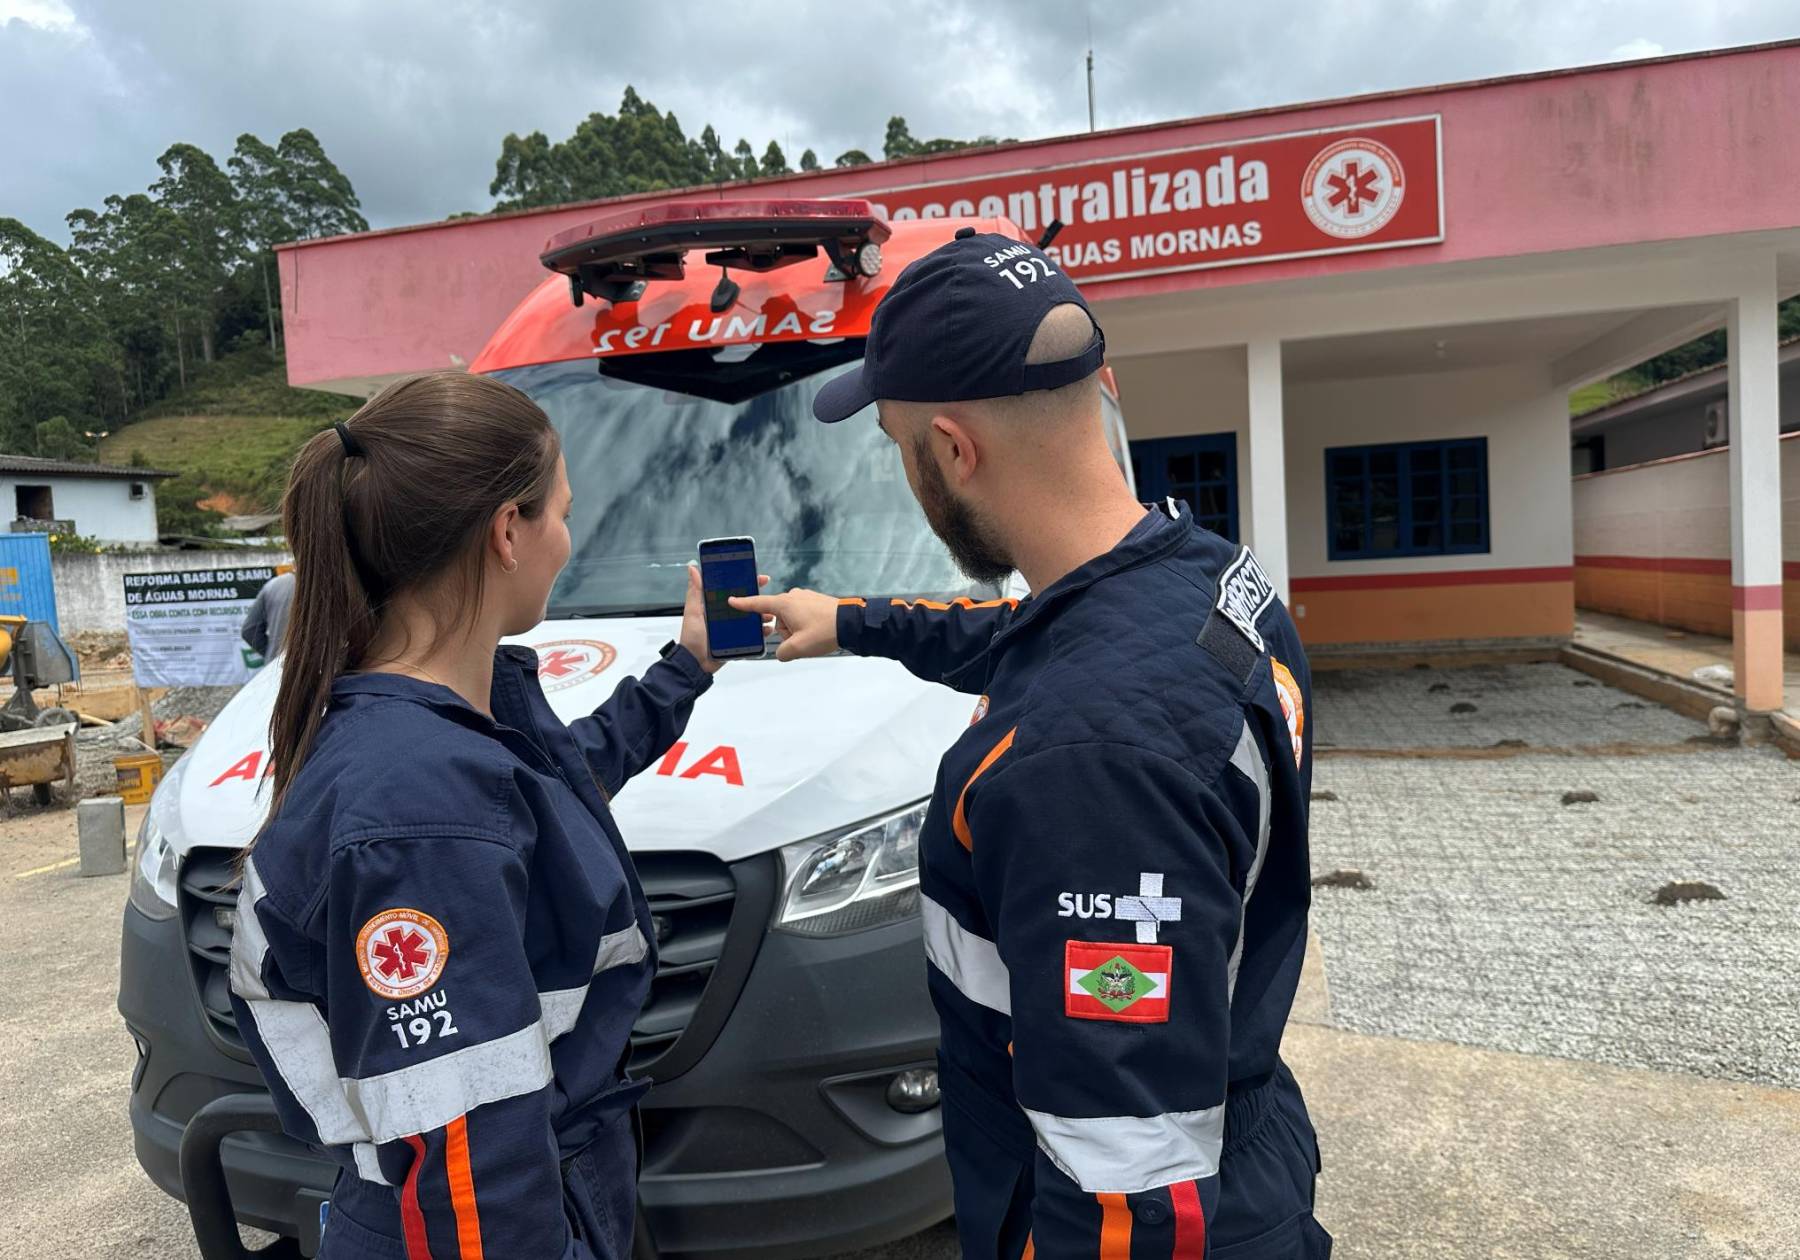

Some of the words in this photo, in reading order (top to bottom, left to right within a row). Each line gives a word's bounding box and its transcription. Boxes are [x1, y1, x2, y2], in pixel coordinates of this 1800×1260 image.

[983, 244, 1031, 268] SAMU
[1043, 239, 1121, 268] GUAS
[1130, 221, 1262, 260] MORNAS
[999, 257, 1057, 289] 192
[125, 574, 181, 587] REFORMA
[183, 572, 215, 584] BASE
[216, 570, 234, 582] DO
[235, 568, 272, 581] SAMU
[127, 592, 143, 604] DE
[187, 587, 239, 600] MORNAS
[1057, 892, 1113, 919] SUS
[386, 989, 448, 1020] SAMU
[391, 1010, 459, 1049] 192
